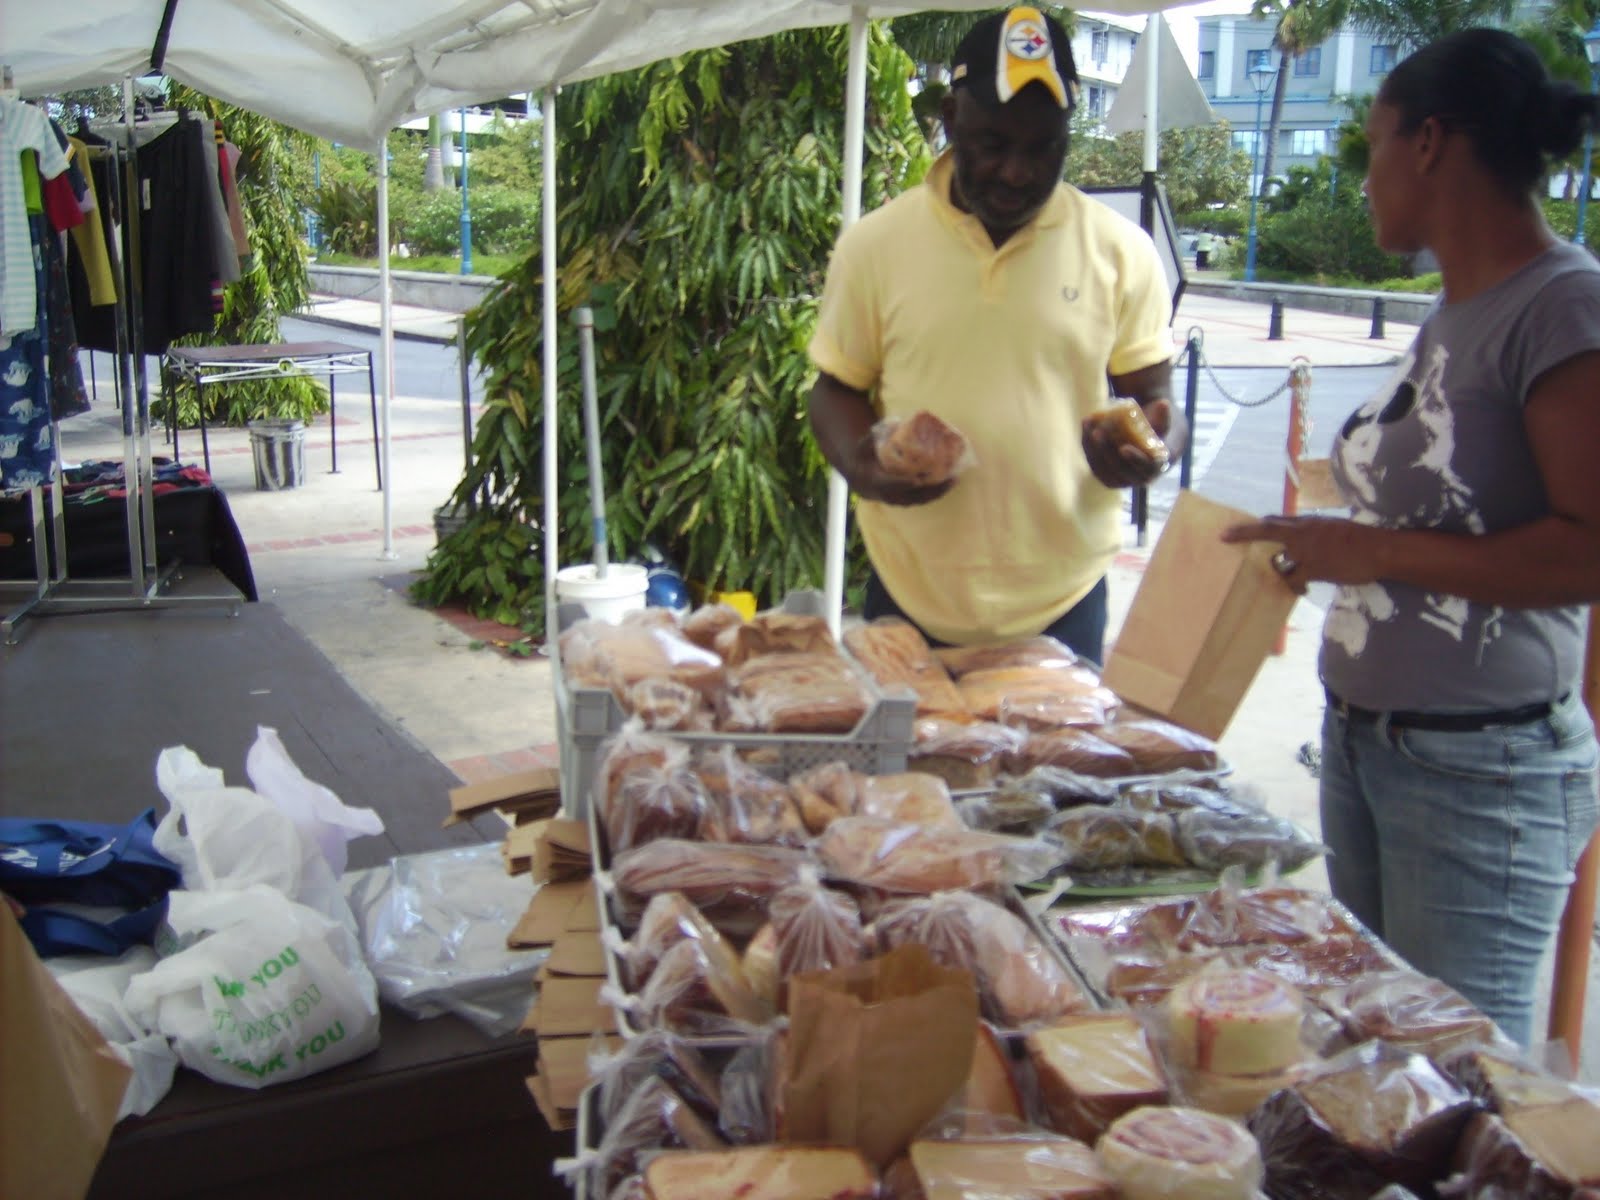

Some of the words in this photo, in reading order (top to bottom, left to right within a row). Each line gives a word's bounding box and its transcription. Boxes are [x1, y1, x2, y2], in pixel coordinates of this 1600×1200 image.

[249, 946, 300, 988] YOU
[277, 984, 322, 1029] YOU
[295, 1020, 346, 1059] YOU
